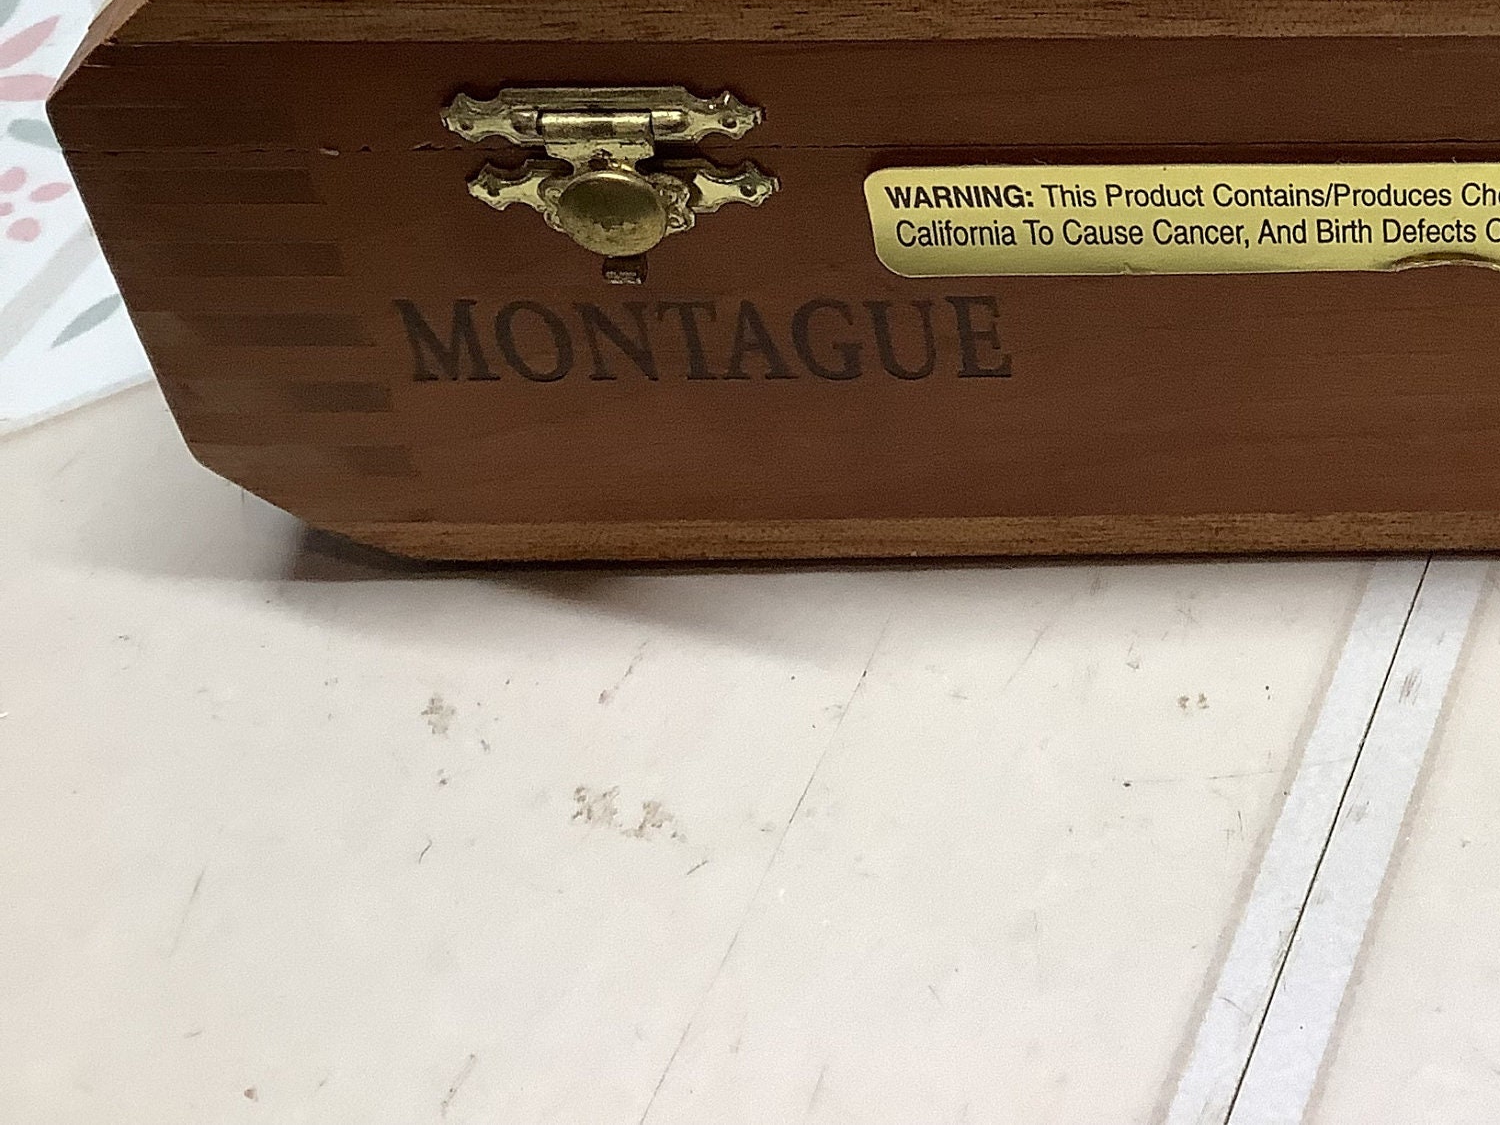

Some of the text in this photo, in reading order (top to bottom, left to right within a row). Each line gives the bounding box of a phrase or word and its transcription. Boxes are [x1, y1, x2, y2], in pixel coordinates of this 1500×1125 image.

[884, 184, 1034, 209] WARNING:
[1041, 183, 1098, 208] This
[1106, 183, 1204, 208] Product
[1212, 182, 1452, 207] Contains/Produces
[896, 219, 1017, 247] California
[1022, 219, 1054, 246] To
[1062, 219, 1144, 246] Cause
[1152, 218, 1250, 249] Cancer,
[1258, 218, 1307, 244] And
[1317, 218, 1373, 244] Birth
[1382, 217, 1477, 244] Defects
[391, 294, 1013, 383] MONTAGUE
